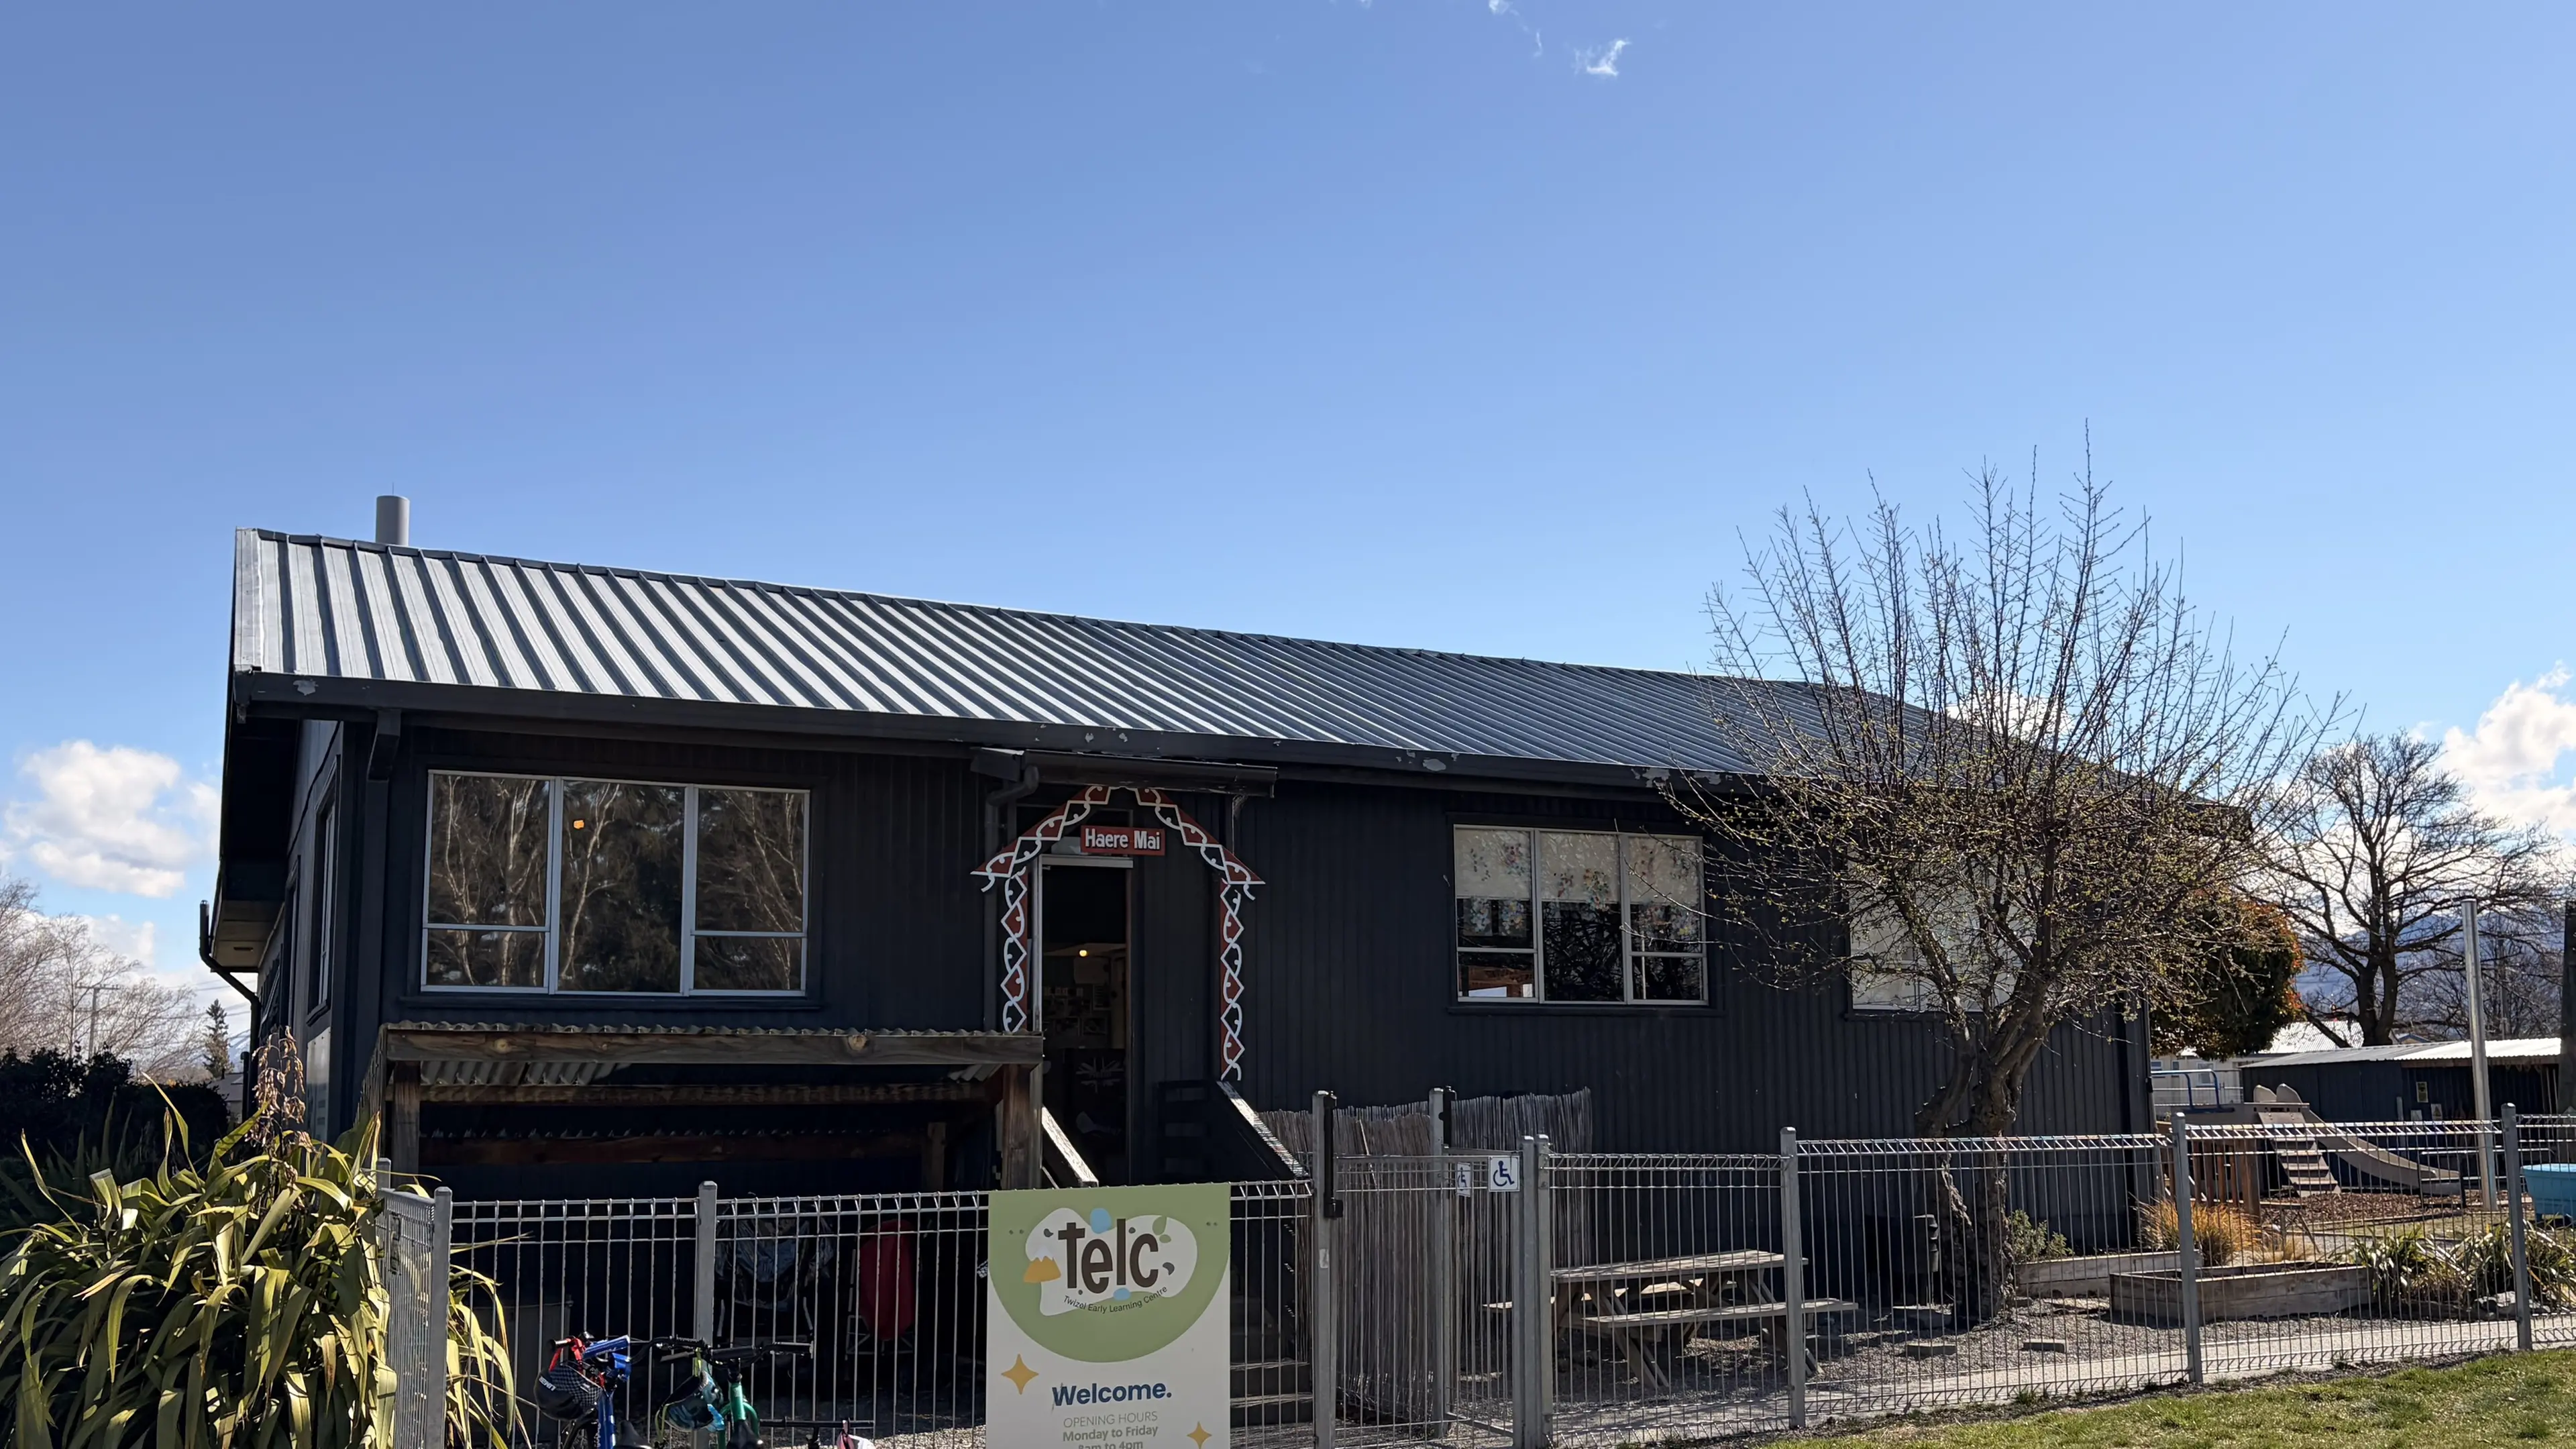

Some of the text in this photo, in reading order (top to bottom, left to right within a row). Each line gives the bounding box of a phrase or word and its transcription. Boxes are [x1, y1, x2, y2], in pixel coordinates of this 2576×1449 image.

[1085, 828, 1161, 849] Haere Mai
[1058, 1218, 1159, 1293] telc
[1063, 1286, 1167, 1313] Twizel Early Learning Centre
[1051, 1383, 1172, 1406] Welcome.
[1063, 1411, 1158, 1428] OPENING HOURS
[1063, 1425, 1158, 1442] Monday to Friday
[1119, 1441, 1143, 1449] 4pm
